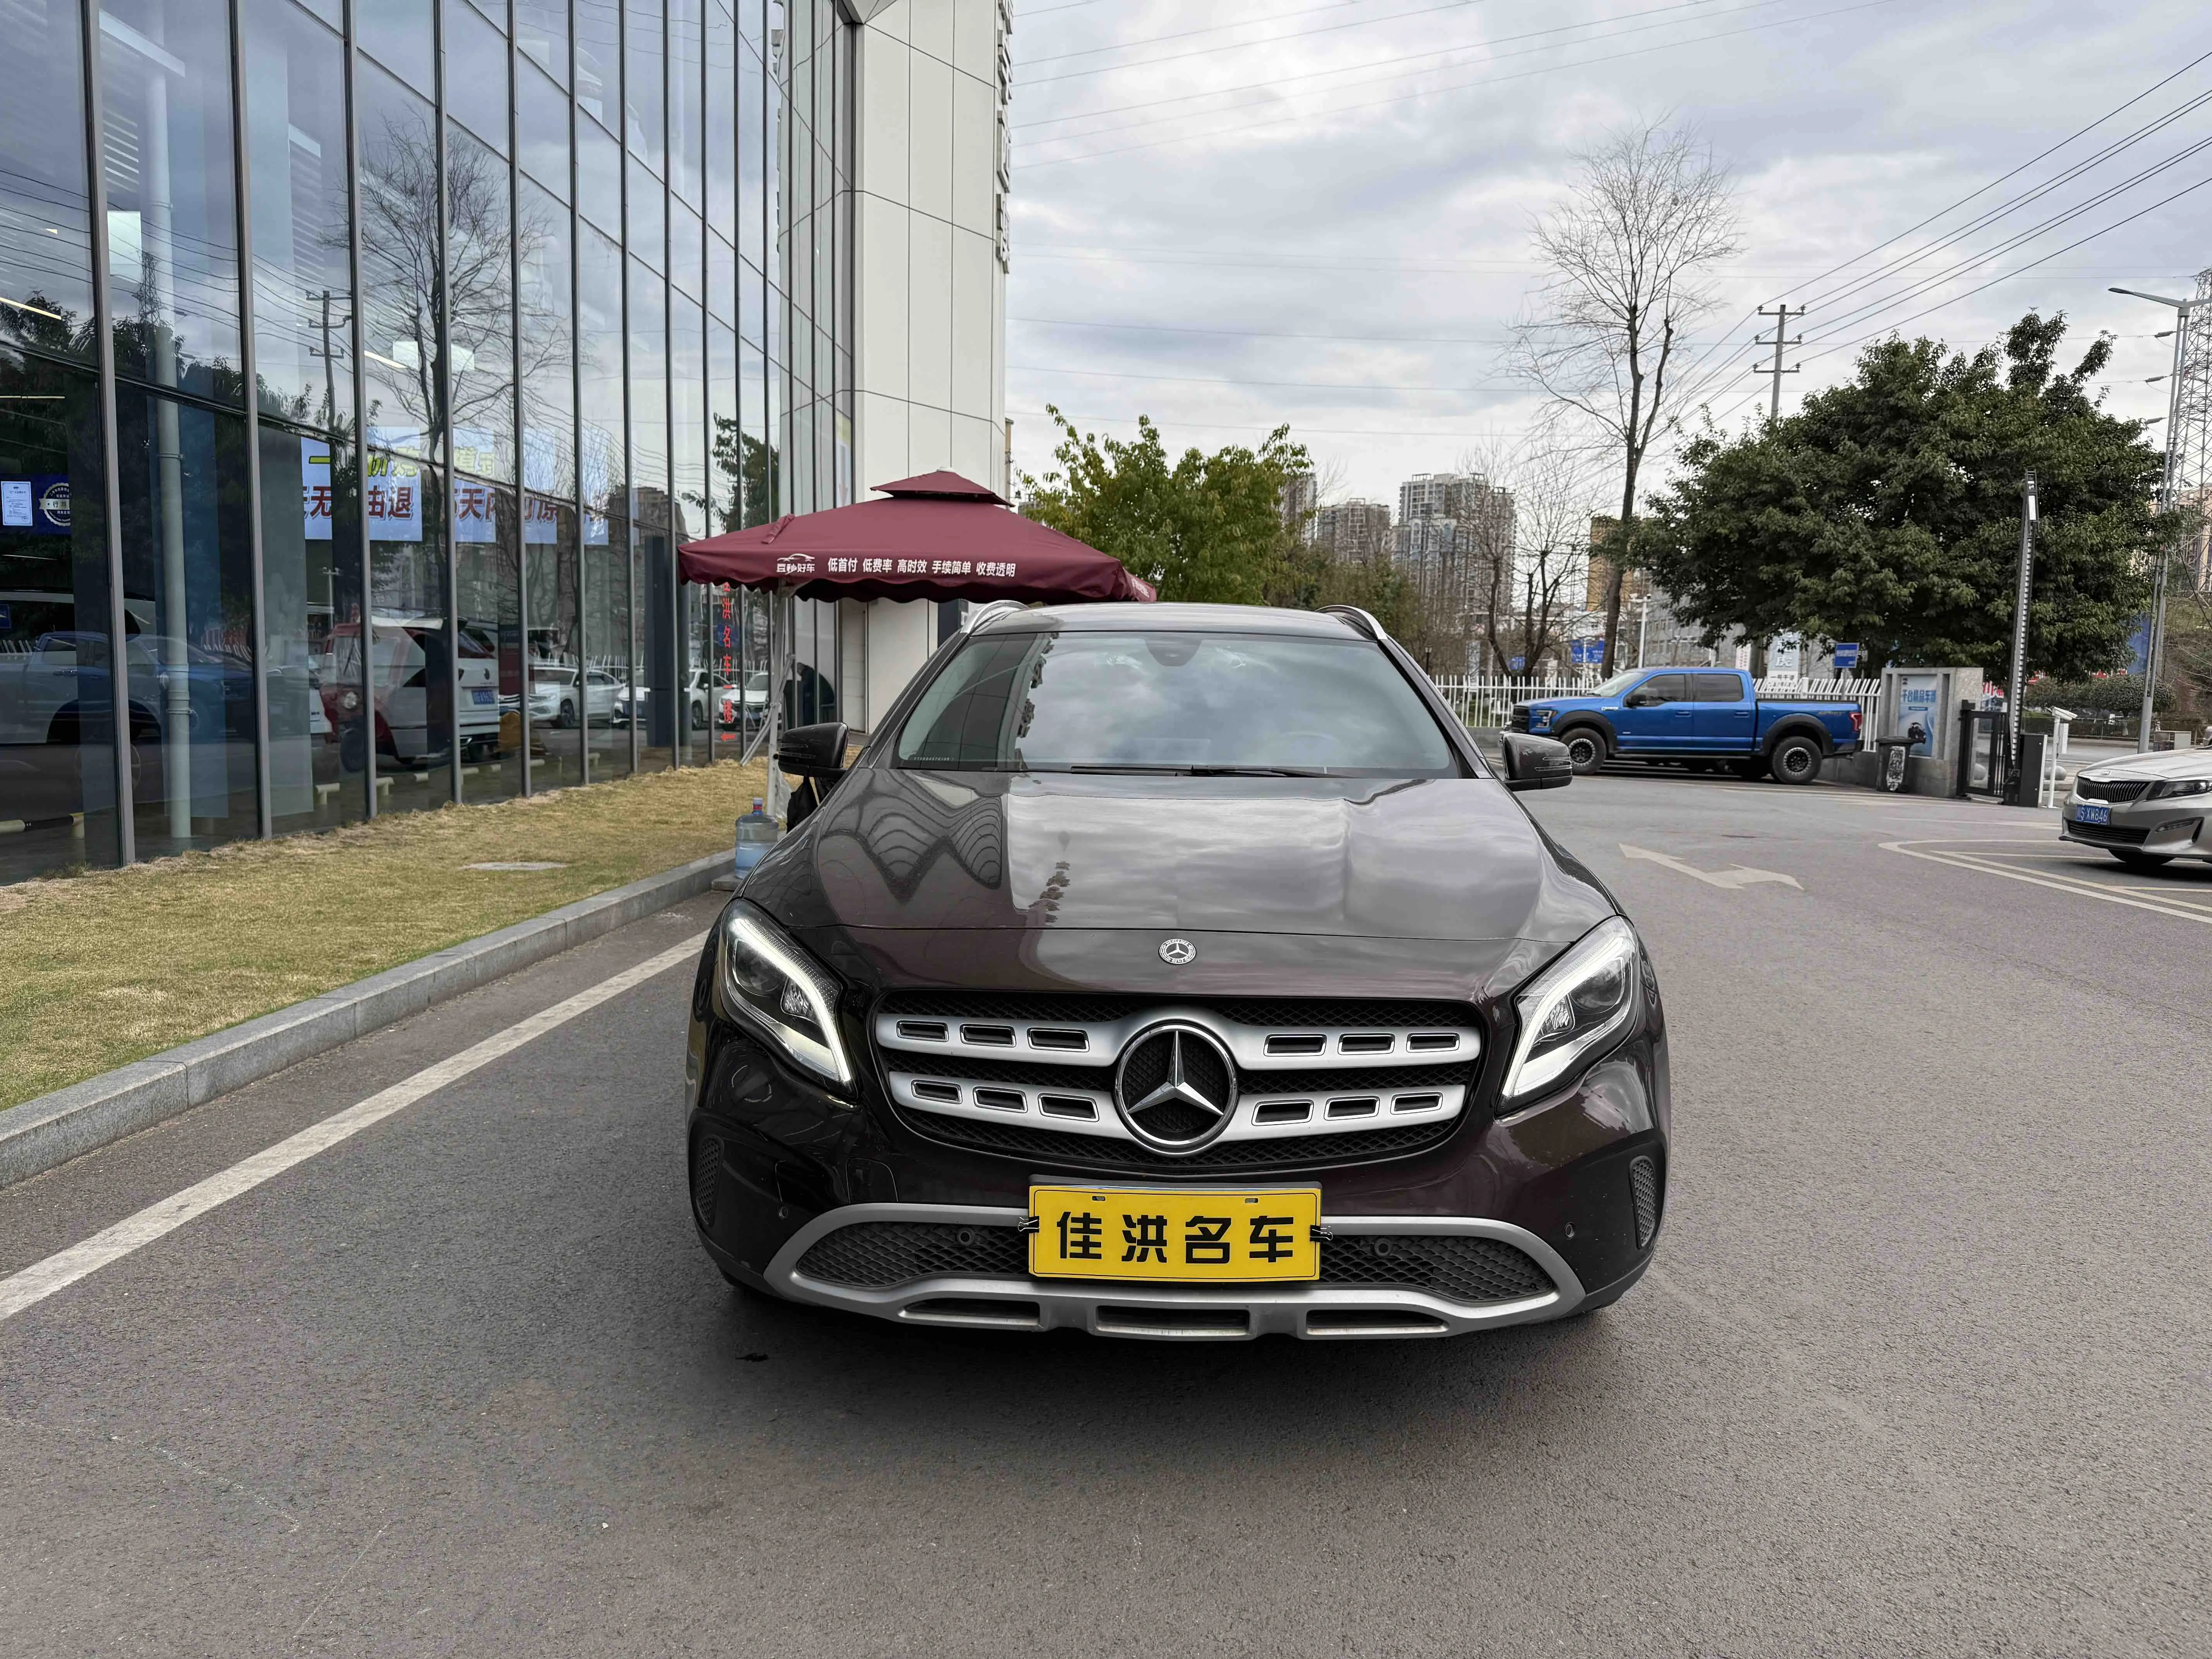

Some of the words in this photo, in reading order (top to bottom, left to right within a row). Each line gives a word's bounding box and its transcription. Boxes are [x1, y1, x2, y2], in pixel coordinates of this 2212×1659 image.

[828, 558, 858, 573] 低首付
[862, 558, 893, 573] 低费率
[897, 559, 927, 573] 高时效
[932, 560, 971, 575] 手续简单
[976, 562, 1016, 577] 收费透明
[1056, 1211, 1294, 1264] 佳洪名车
